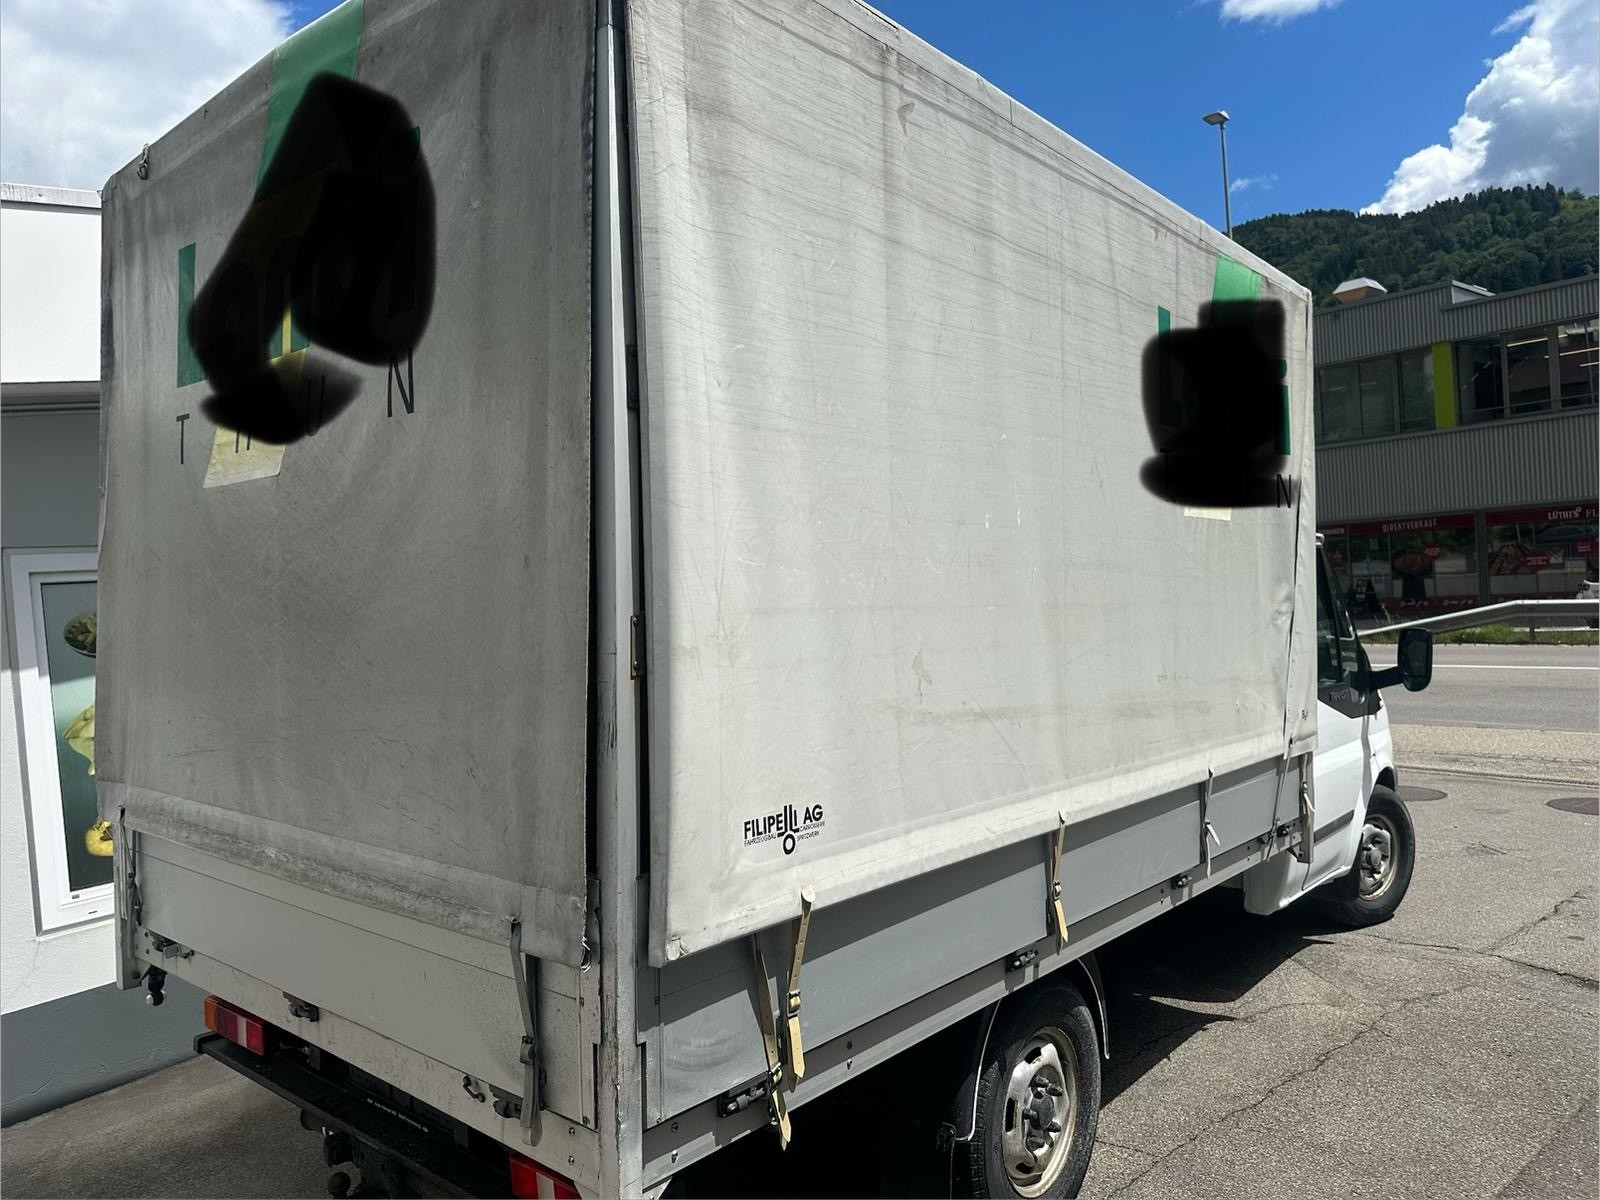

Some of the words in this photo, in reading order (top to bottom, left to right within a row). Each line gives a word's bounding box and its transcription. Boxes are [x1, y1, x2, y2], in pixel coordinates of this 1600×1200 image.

[1585, 508, 1599, 518] FL
[1381, 517, 1438, 533] DIREKTVERKAUF
[743, 804, 799, 840] FILIPELLI
[802, 804, 823, 824] AG
[743, 832, 777, 847] FAHRZEUGBAU
[796, 830, 821, 842] SPRITZWERK
